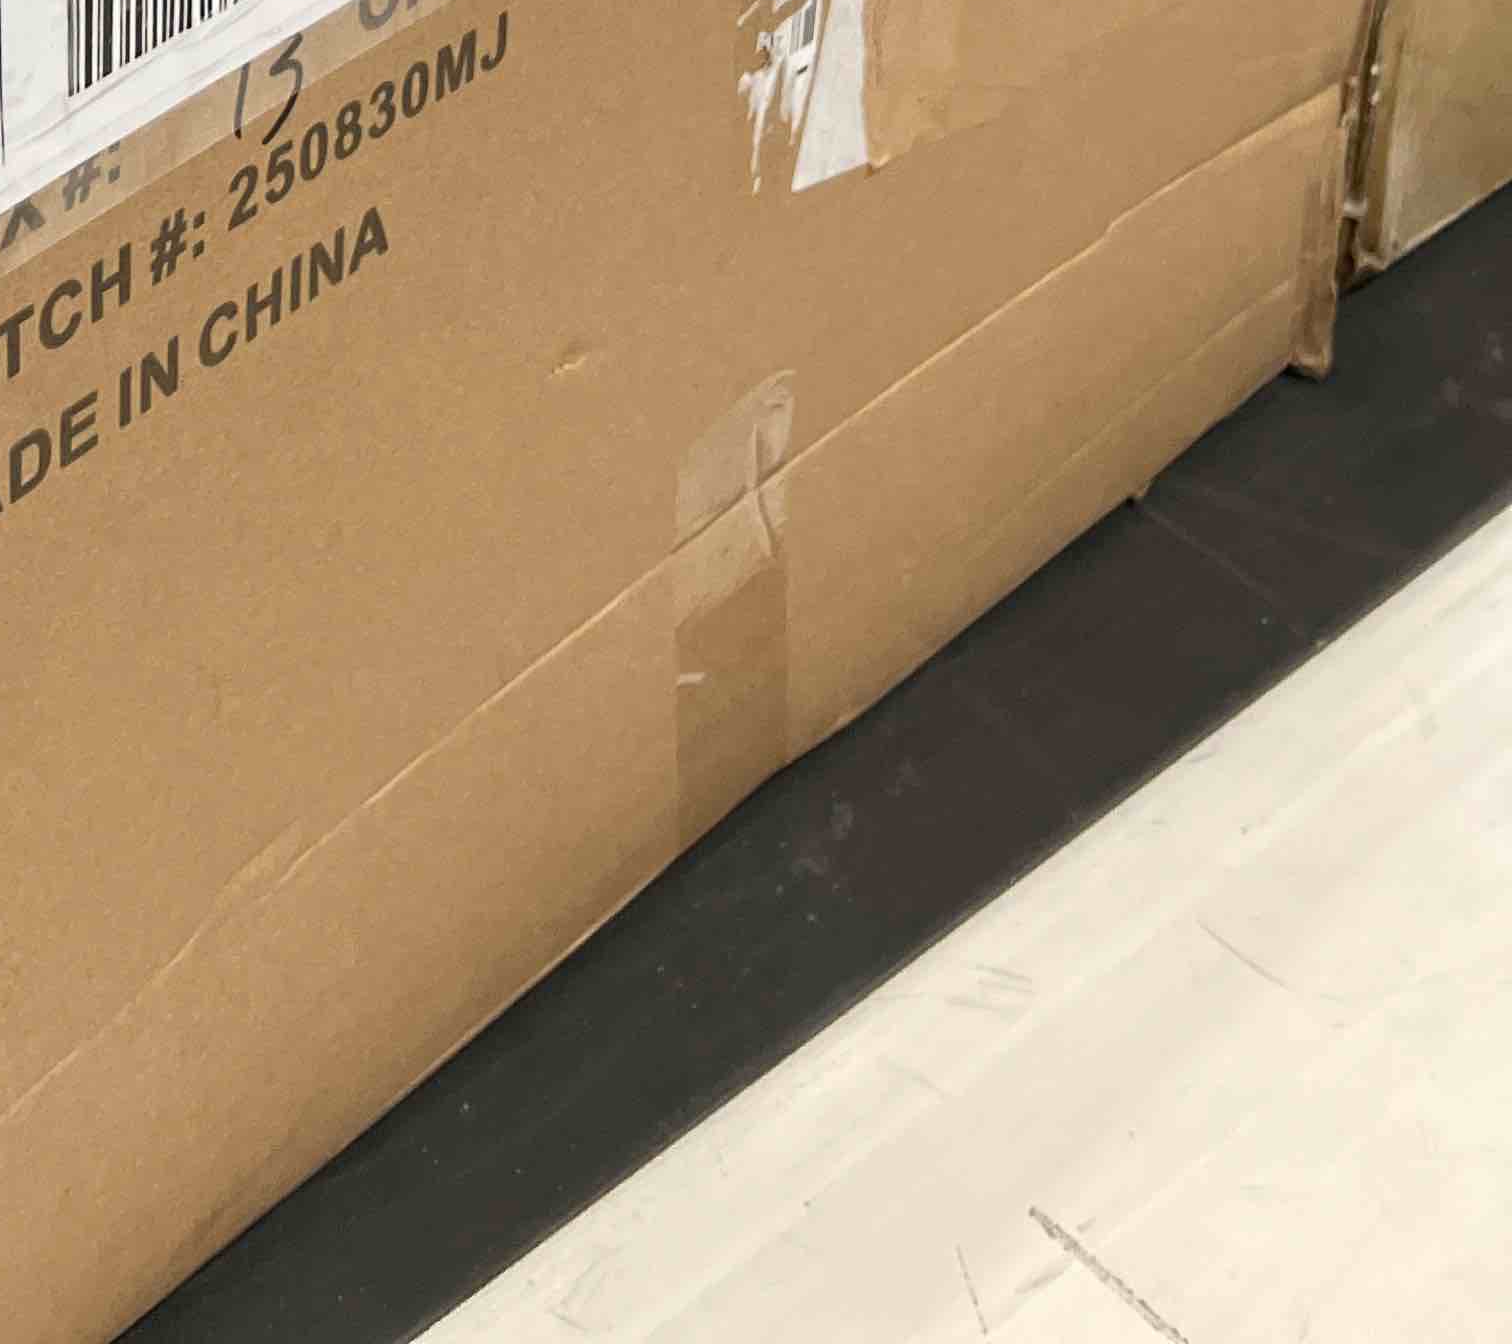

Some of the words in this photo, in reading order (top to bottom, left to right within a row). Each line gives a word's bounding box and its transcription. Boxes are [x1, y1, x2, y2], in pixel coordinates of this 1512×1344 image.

[150, 209, 207, 288] #:
[227, 11, 510, 233] 250830MJ
[118, 335, 180, 431] IN
[198, 206, 390, 368] CHINA
